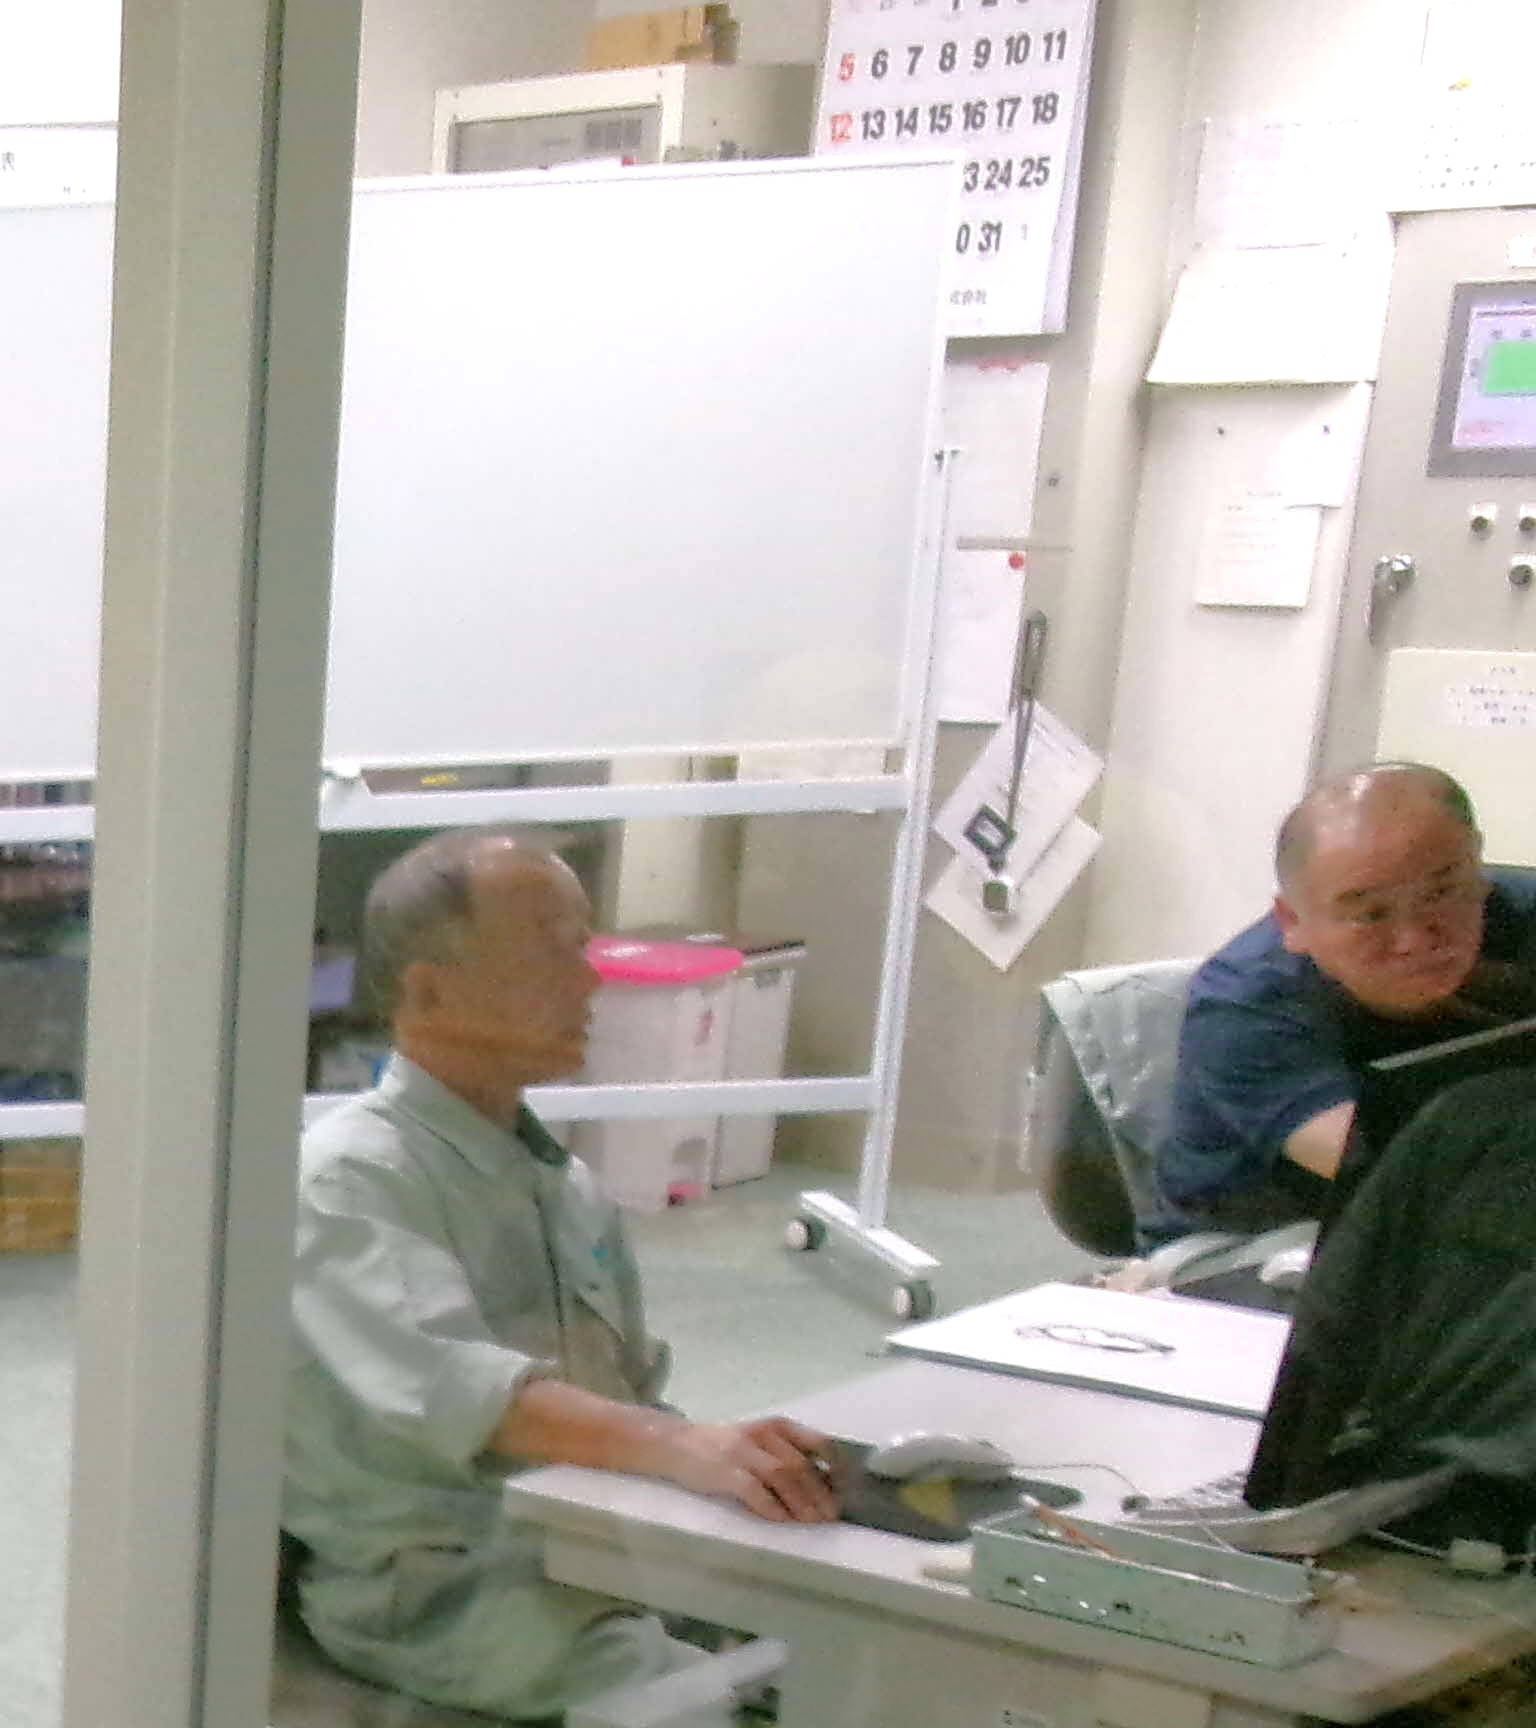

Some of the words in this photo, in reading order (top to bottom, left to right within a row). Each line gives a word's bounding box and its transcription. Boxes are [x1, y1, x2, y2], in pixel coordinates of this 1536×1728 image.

[838, 53, 854, 81] 5
[871, 50, 888, 79] 6
[907, 46, 924, 76] 7
[938, 42, 957, 73] 8
[973, 38, 991, 68] 9
[1004, 32, 1030, 65] 10
[1043, 29, 1067, 61] 11
[830, 113, 853, 143] 12
[862, 110, 886, 140] 13
[895, 107, 919, 136] 14
[928, 103, 952, 133] 15
[962, 100, 986, 130] 16
[996, 97, 1021, 127] 17
[1031, 92, 1059, 124] 18
[962, 162, 978, 193] 3
[984, 160, 1012, 190] 24
[1018, 156, 1050, 187] 25
[955, 223, 970, 254] 0
[978, 221, 1003, 252] 31
